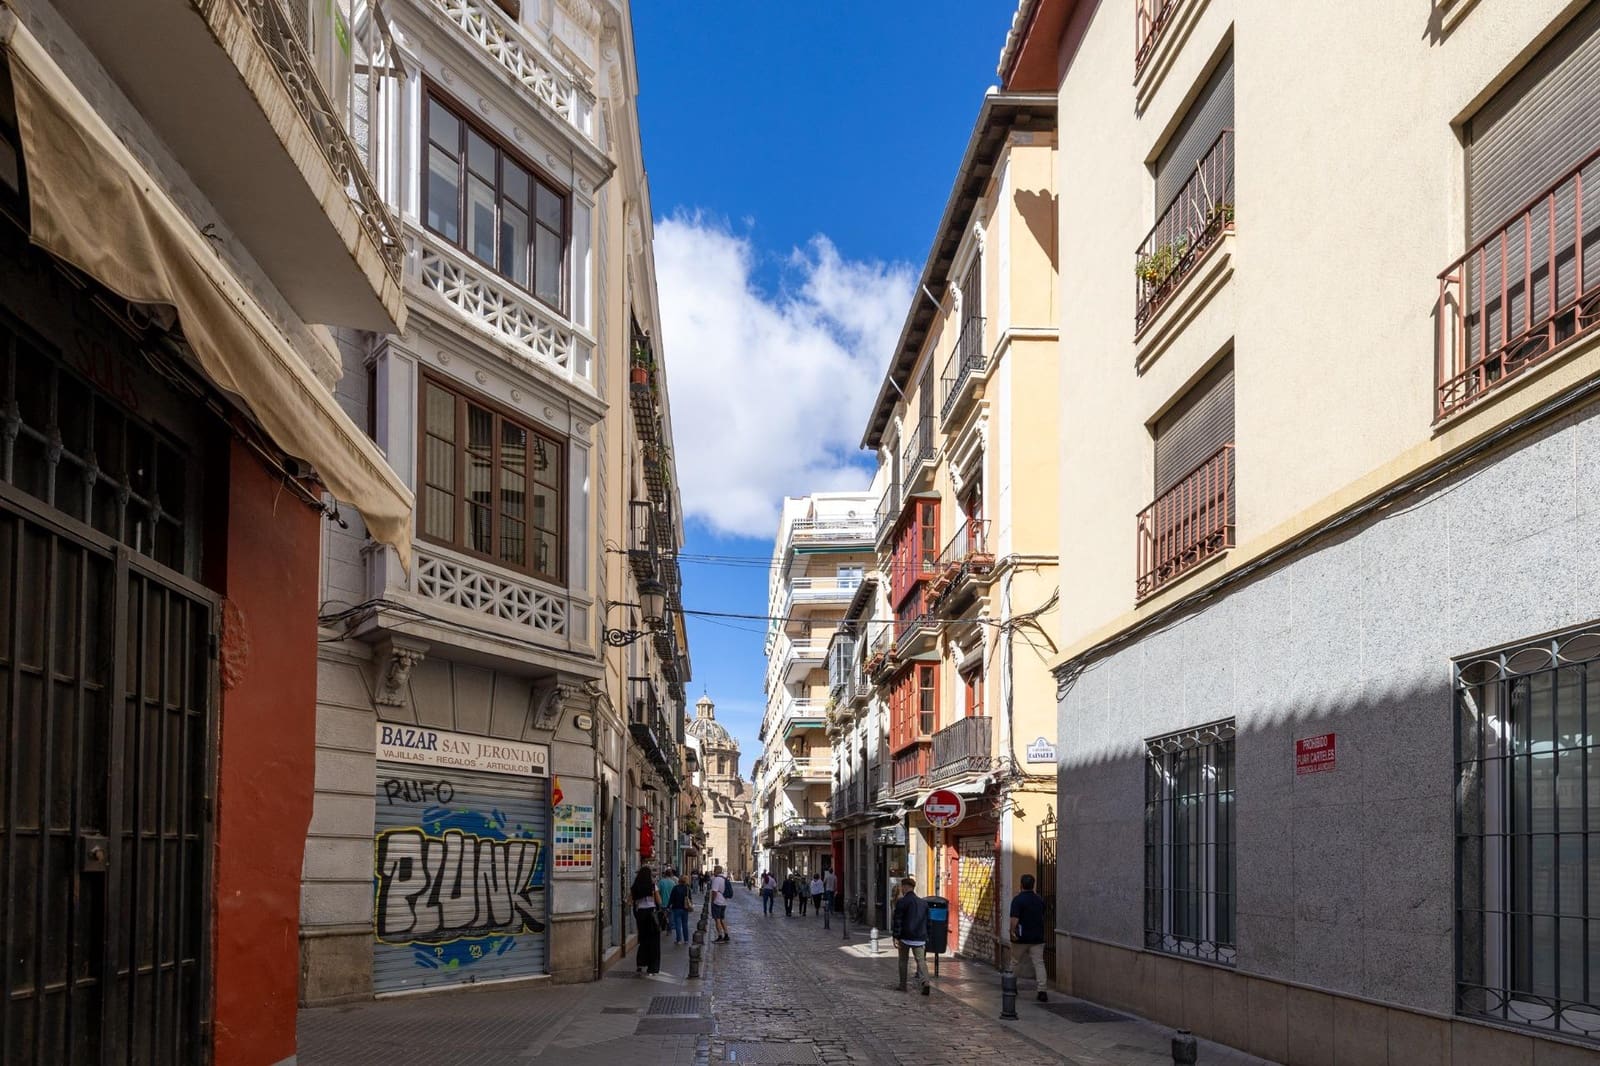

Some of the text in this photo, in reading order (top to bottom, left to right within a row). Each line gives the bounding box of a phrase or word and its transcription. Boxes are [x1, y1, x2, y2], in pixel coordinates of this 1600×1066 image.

[381, 726, 546, 765] BAZAR SAN JERONIMO
[1311, 749, 1334, 761] CARTELES
[383, 749, 425, 761] VAJILLAS
[436, 755, 477, 767] REGALOS
[486, 762, 529, 773] ARTICULOS
[384, 779, 455, 805] RUFO
